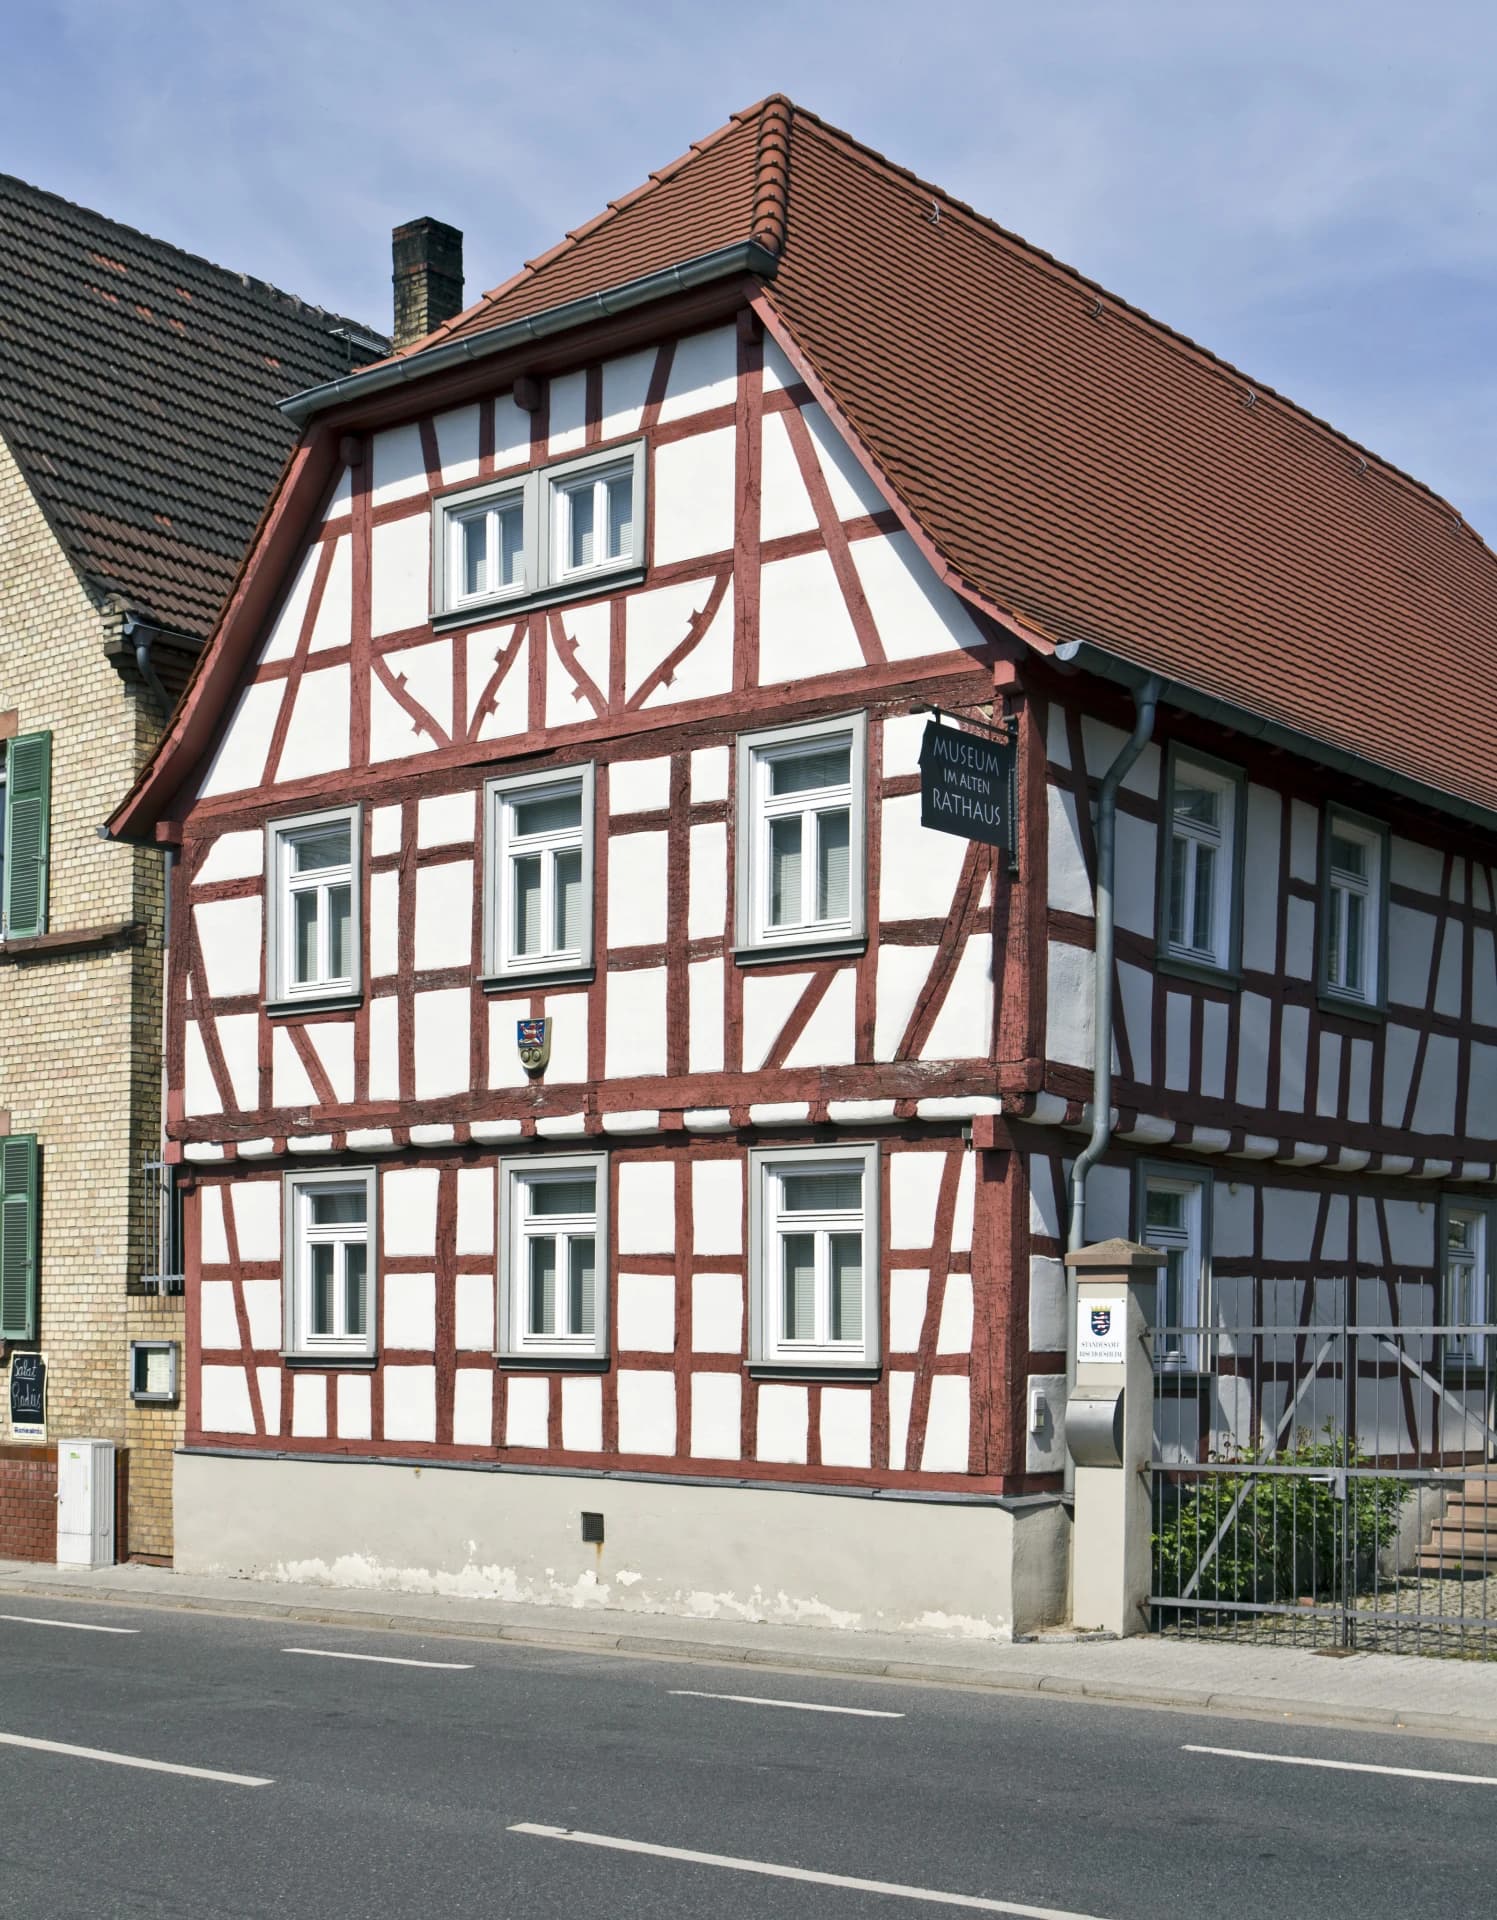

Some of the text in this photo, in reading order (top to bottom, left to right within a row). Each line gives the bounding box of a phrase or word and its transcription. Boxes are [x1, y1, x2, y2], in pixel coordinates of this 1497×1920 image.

[933, 736, 1000, 776] MUSEUM
[944, 768, 990, 796] IM ALTEN
[933, 787, 1001, 826] RATHAUS
[14, 1358, 37, 1377] Salat
